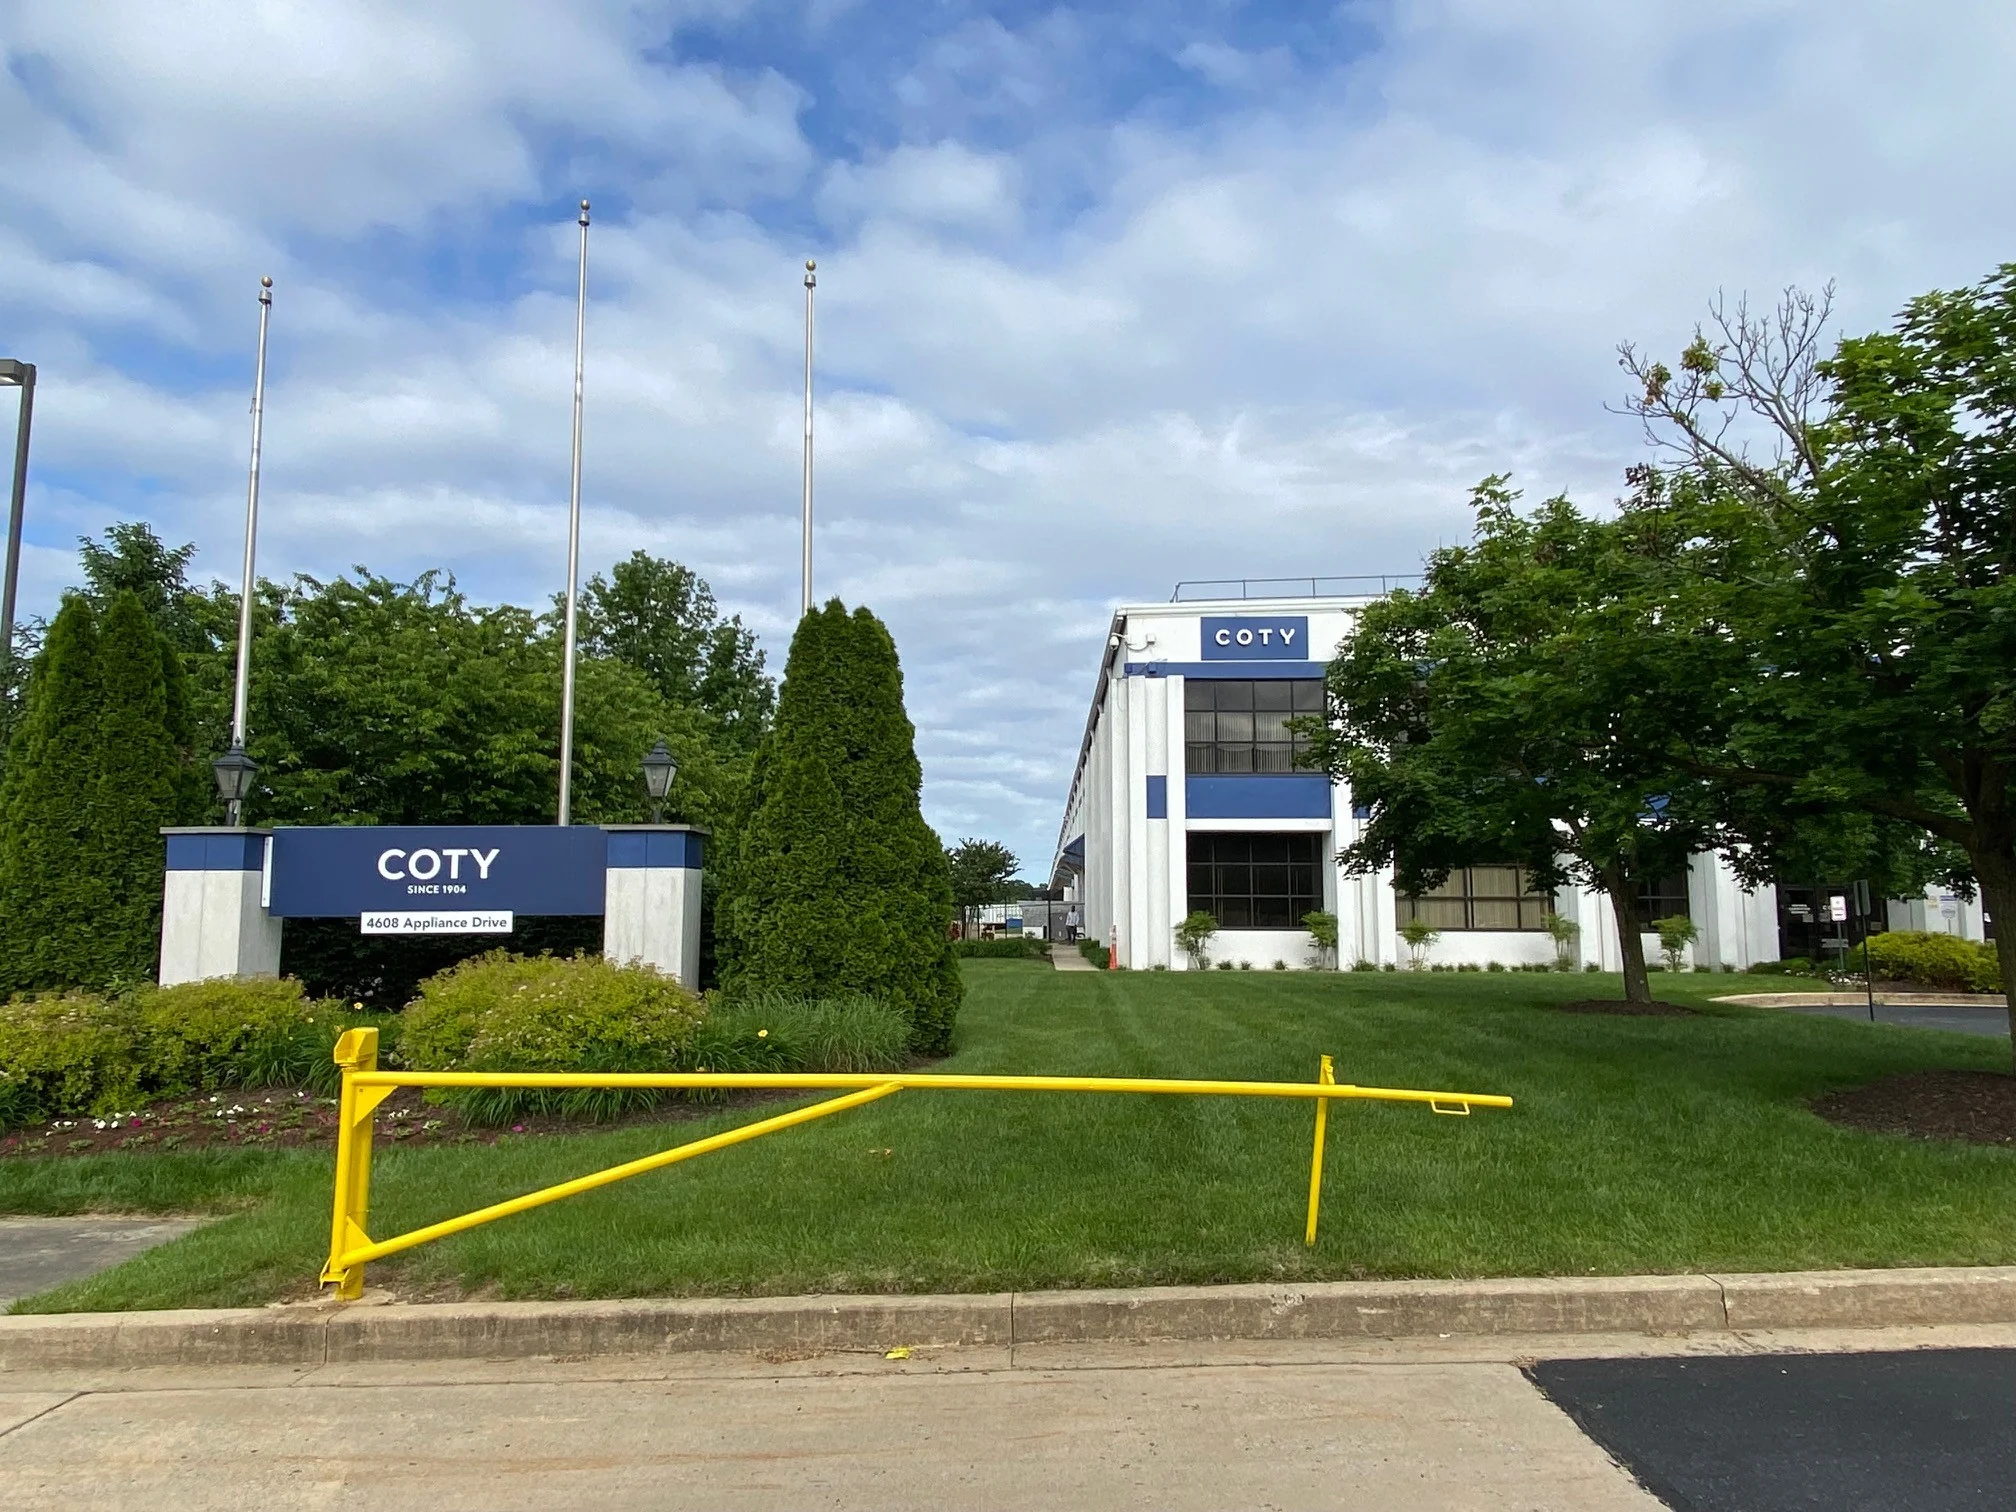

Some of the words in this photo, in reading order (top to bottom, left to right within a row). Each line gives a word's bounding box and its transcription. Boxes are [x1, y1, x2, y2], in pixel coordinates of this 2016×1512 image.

[1215, 628, 1295, 645] COTY
[377, 848, 500, 880] COTY
[407, 884, 439, 894] SINCE
[442, 884, 467, 894] 1904
[366, 917, 399, 928] 4608
[403, 917, 468, 931] Appliance
[472, 917, 507, 928] Drive
